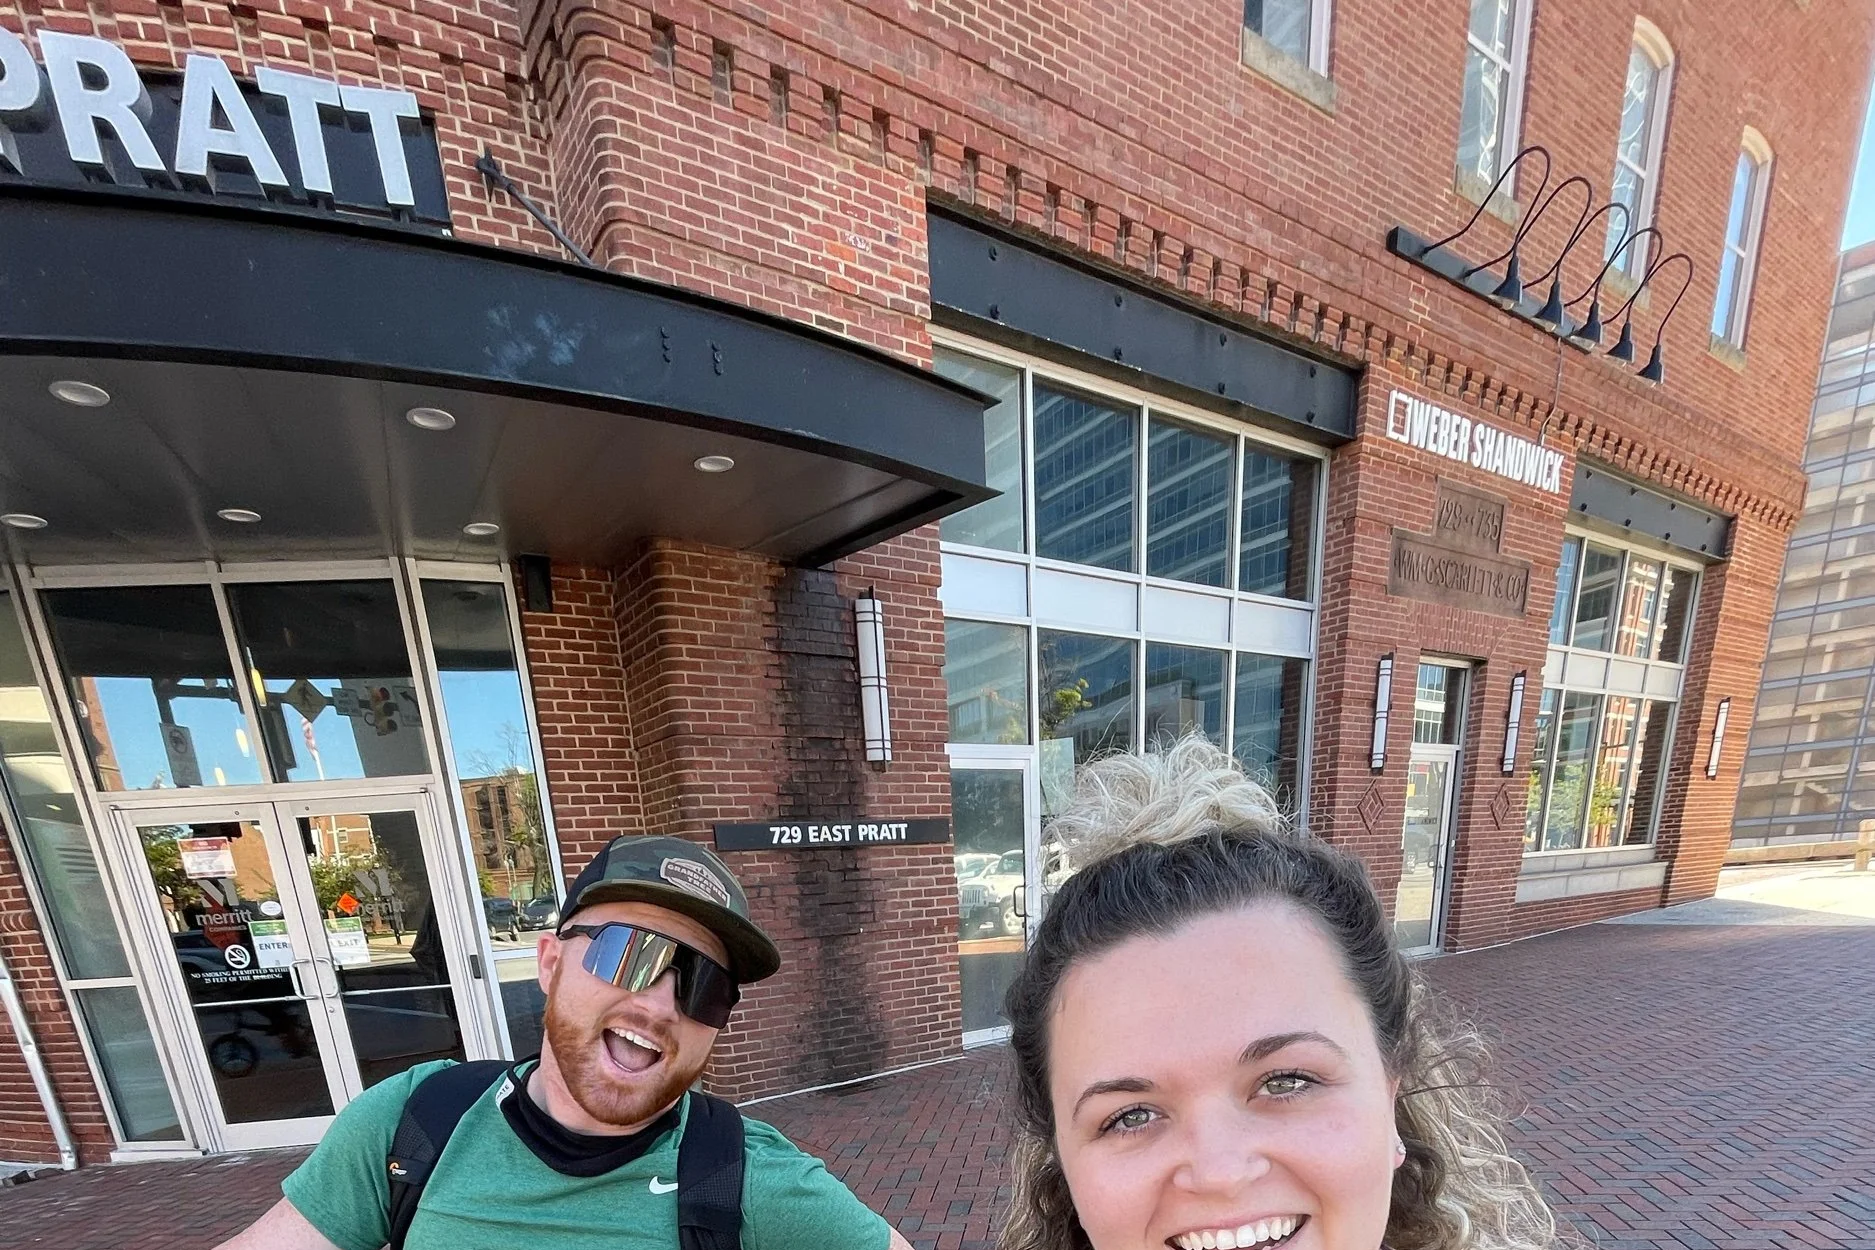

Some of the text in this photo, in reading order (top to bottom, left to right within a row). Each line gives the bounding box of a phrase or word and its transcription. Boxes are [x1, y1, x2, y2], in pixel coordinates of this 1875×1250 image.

[1410, 398, 1565, 494] WEBER SHANDWICK
[769, 823, 908, 844] 729 EAST PRATT
[666, 863, 727, 902] GRANDFATHER
[687, 876, 712, 894] TREE
[195, 908, 255, 926] merritt
[258, 942, 289, 951] ENTER
[339, 938, 359, 947] EXIT
[202, 970, 231, 978] SMOKING
[231, 968, 268, 976] PERMITTED
[212, 976, 228, 984] FEET
